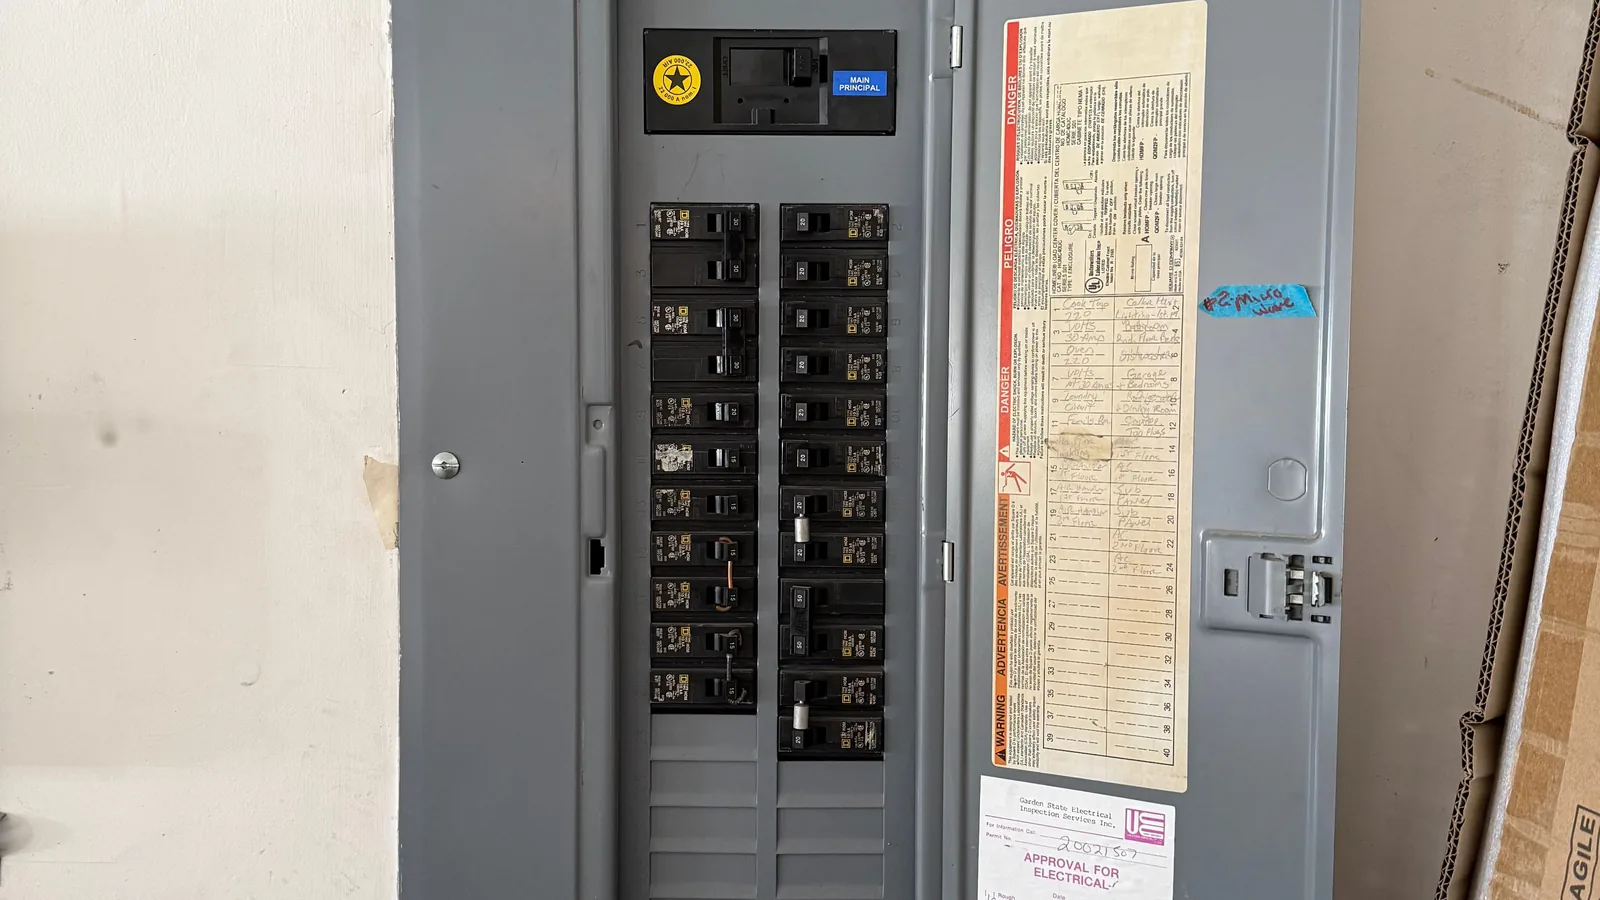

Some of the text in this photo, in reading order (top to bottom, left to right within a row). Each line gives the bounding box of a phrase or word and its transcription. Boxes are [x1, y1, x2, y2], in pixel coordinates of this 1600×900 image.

[662, 59, 672, 68] AIR
[849, 76, 870, 84] MAIN
[839, 84, 880, 92] PRINCIPAL
[1007, 76, 1016, 124] DANGER
[800, 217, 806, 226] 20
[1004, 219, 1013, 268] PELIGRO
[799, 267, 804, 275] 20
[1063, 298, 1086, 308] Cook
[799, 315, 804, 323] 20
[799, 361, 804, 369] 20
[1000, 366, 1009, 413] DANGER
[1170, 398, 1177, 406] 10
[1169, 422, 1177, 430] 12
[1169, 445, 1176, 453] 14
[1050, 464, 1057, 473] 15
[1168, 469, 1176, 478] 16
[1167, 492, 1175, 501] 18
[1050, 509, 1057, 517] 19
[1167, 515, 1175, 524] 20
[1050, 533, 1057, 541] 21
[1166, 539, 1174, 548] 22
[797, 548, 802, 556] 20
[1049, 555, 1056, 563] 23
[1166, 562, 1174, 572] 24
[1049, 577, 1056, 585] 25
[1165, 585, 1173, 595] 26
[1048, 600, 1056, 608] 27
[1165, 610, 1173, 618] 28
[996, 496, 1008, 747] WARNING ADVERTENCIA AVERTISSEMENT
[1048, 622, 1056, 631] 29
[1165, 632, 1172, 641] 30
[1048, 644, 1055, 652] 31
[1165, 655, 1172, 664] 32
[1048, 667, 1055, 675] 33
[1164, 679, 1172, 688] 34
[1047, 689, 1055, 698] 35
[1164, 702, 1171, 711] 36
[1047, 711, 1054, 719] 37
[1163, 725, 1171, 734] 38
[1047, 733, 1054, 742] 39
[1163, 749, 1170, 758] 40
[1020, 797, 1112, 820] Garden State Electrical
[1020, 805, 1116, 829] Inspection Services Inc.
[1024, 852, 1119, 879] APPROVAL FOR
[1034, 868, 1110, 890] ELECTRICAL
